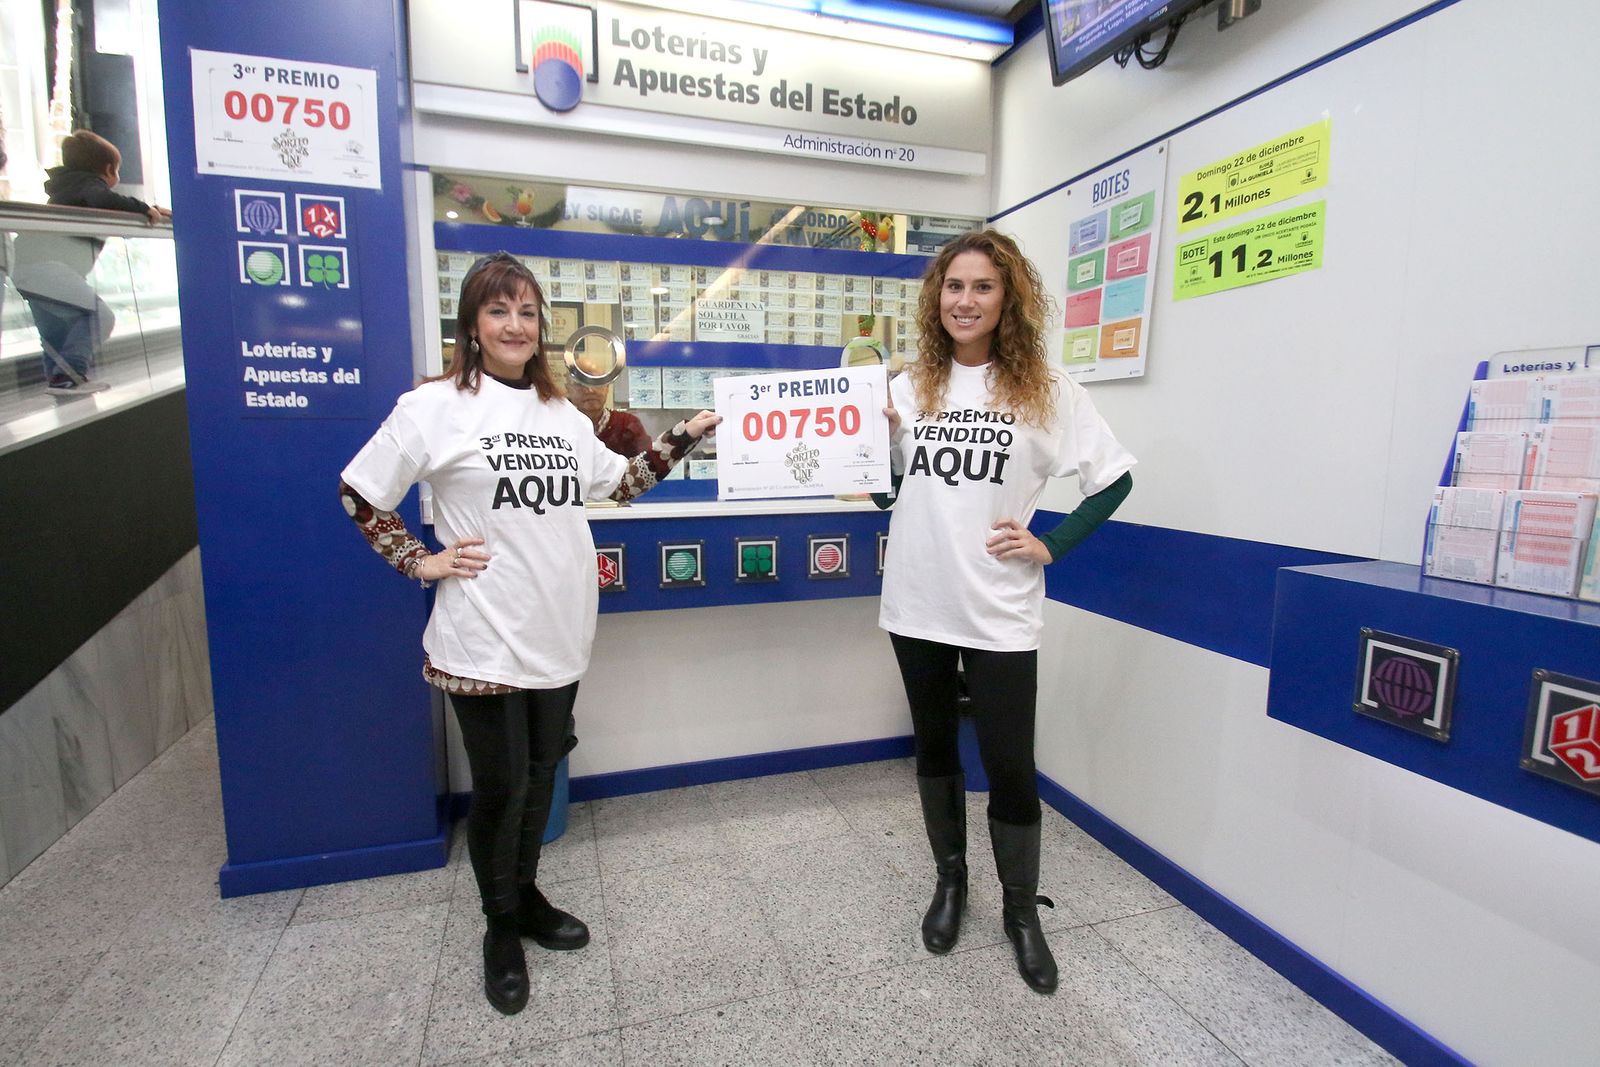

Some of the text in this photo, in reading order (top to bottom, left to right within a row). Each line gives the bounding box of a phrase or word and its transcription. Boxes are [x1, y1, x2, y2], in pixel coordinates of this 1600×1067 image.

[611, 17, 769, 76] Loterías y
[233, 63, 340, 89] 3er PREMIO
[613, 58, 918, 126] Apuestas del Estado
[224, 90, 351, 131] 00750
[783, 134, 881, 158] Administración
[899, 148, 915, 162] 20
[1197, 164, 1232, 181] Domingo
[1234, 157, 1244, 168] 22
[1246, 151, 1257, 163] de
[1259, 135, 1305, 158] diciembre
[1093, 169, 1130, 204] BOTES
[1225, 188, 1271, 210] Millones
[1226, 228, 1255, 240] domingo
[1256, 223, 1266, 232] 22
[1278, 211, 1317, 226] diciembre
[1182, 246, 1206, 260] BOTE
[1277, 251, 1314, 264] Millones
[698, 301, 764, 311] GUARDEN UNA
[698, 311, 746, 320] SOLA FILA
[698, 321, 751, 331] POR FAVOR
[241, 341, 333, 363] Loterías y
[243, 366, 361, 386] Apuestas del
[1503, 361, 1577, 373] Loterías y
[750, 376, 850, 401] 3er PREMIO
[245, 392, 309, 408] Estado
[742, 404, 861, 442] 00750
[936, 409, 1016, 425] PREMIO
[504, 432, 573, 451] PREMIO
[913, 425, 1013, 447] VENDIDO
[486, 453, 579, 472] VENDIDO
[908, 445, 1011, 487] AQUÍ
[491, 473, 584, 515] AQUÍ
